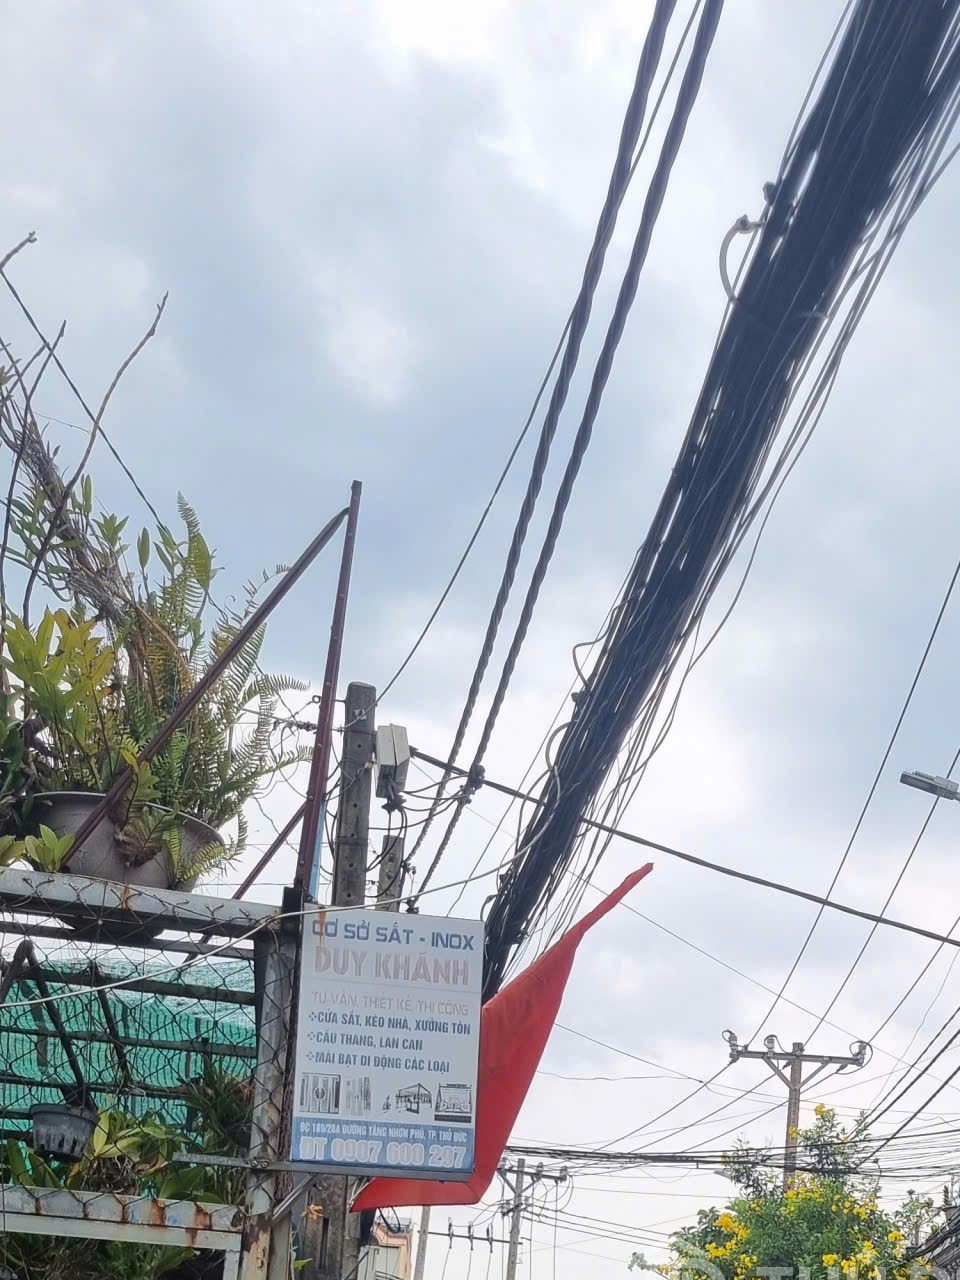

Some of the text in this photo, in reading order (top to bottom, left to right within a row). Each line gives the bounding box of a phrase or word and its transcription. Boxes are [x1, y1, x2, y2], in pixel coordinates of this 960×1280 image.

[312, 918, 339, 938] CƠ
[344, 920, 370, 941] SỞ
[376, 922, 414, 945] SẮT
[431, 931, 475, 951] INOX
[314, 945, 470, 986] DUY KHÁNH
[318, 1007, 338, 1025] CỬA
[340, 1033, 377, 1048] THANG,
[380, 1036, 399, 1049] LAN
[402, 1038, 423, 1051] CAN
[338, 1053, 358, 1068] BẠT
[361, 1055, 371, 1067] DI
[404, 1056, 425, 1071] CÁC
[428, 1060, 450, 1075] LOẠI
